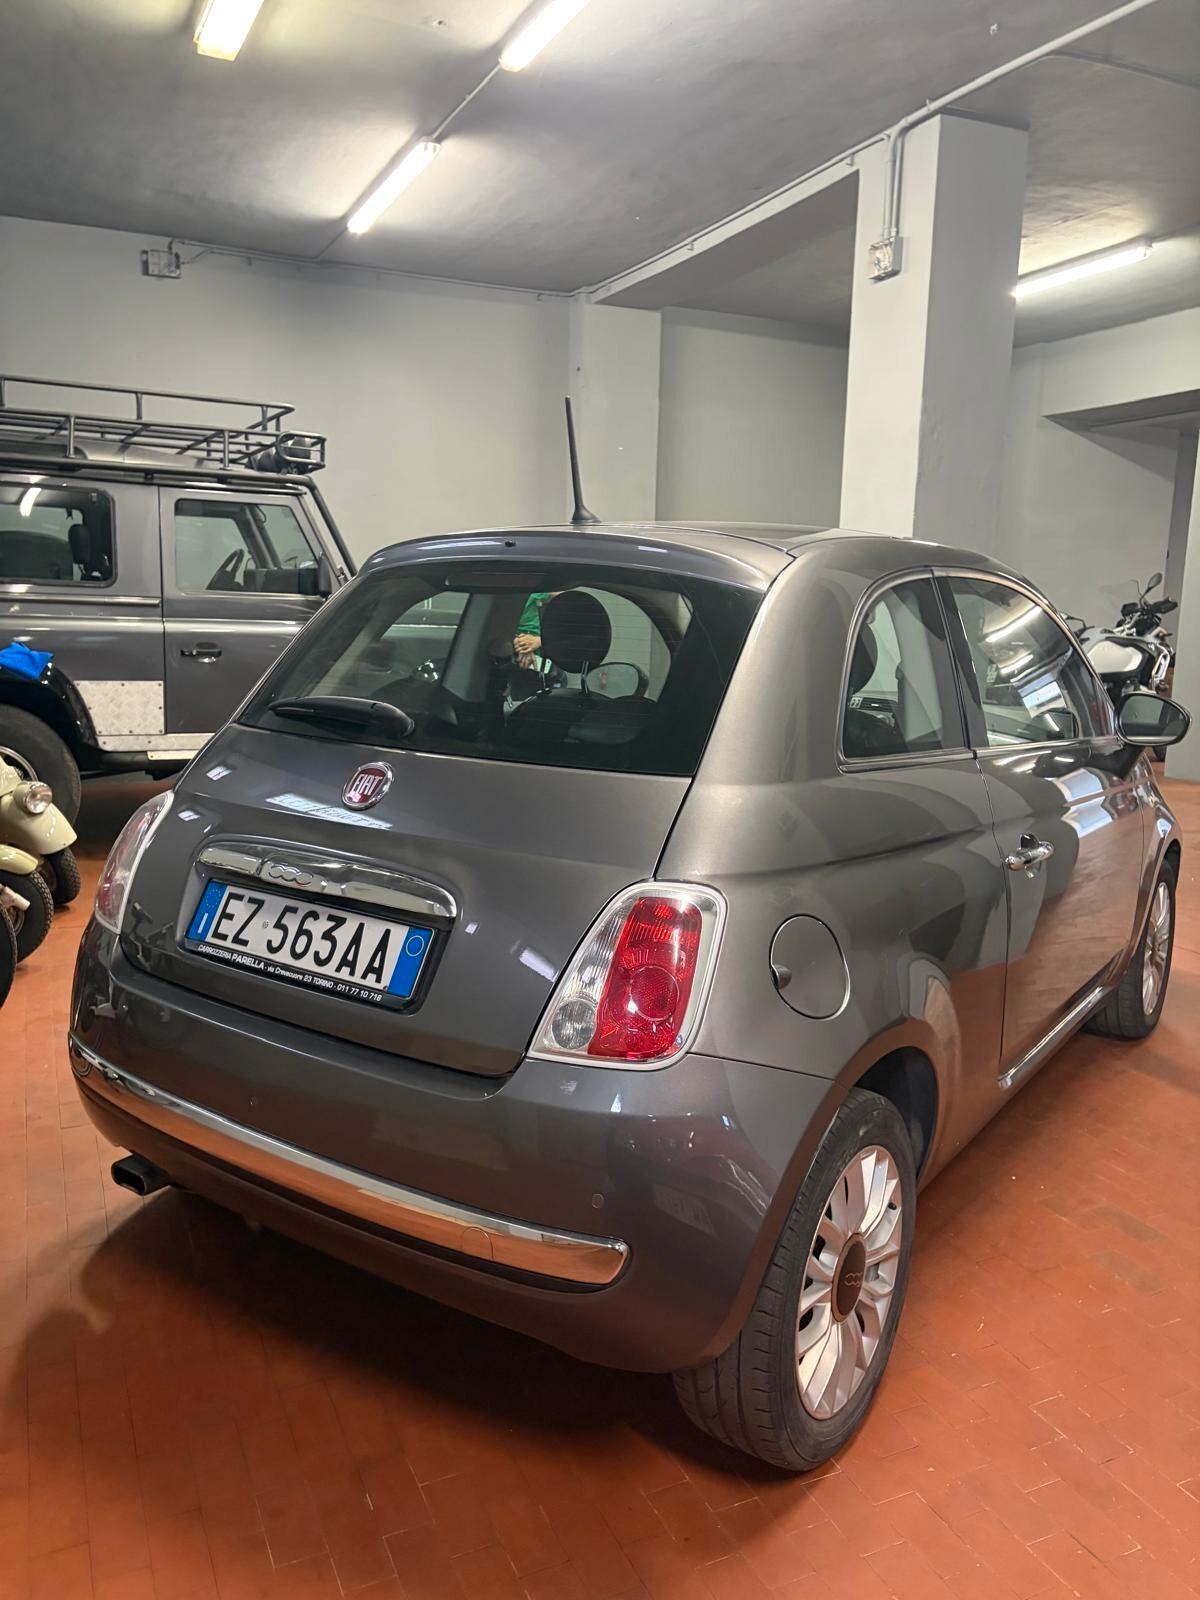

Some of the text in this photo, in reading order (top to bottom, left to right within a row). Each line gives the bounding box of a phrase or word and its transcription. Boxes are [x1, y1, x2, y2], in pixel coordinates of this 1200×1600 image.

[349, 773, 384, 796] FIAT
[210, 891, 392, 984] EZ 563AA
[197, 944, 231, 960] CARROZZERIA
[231, 953, 265, 970] PARELLA
[303, 974, 312, 983] 23
[312, 977, 334, 989] TORINO
[349, 987, 360, 996] 77
